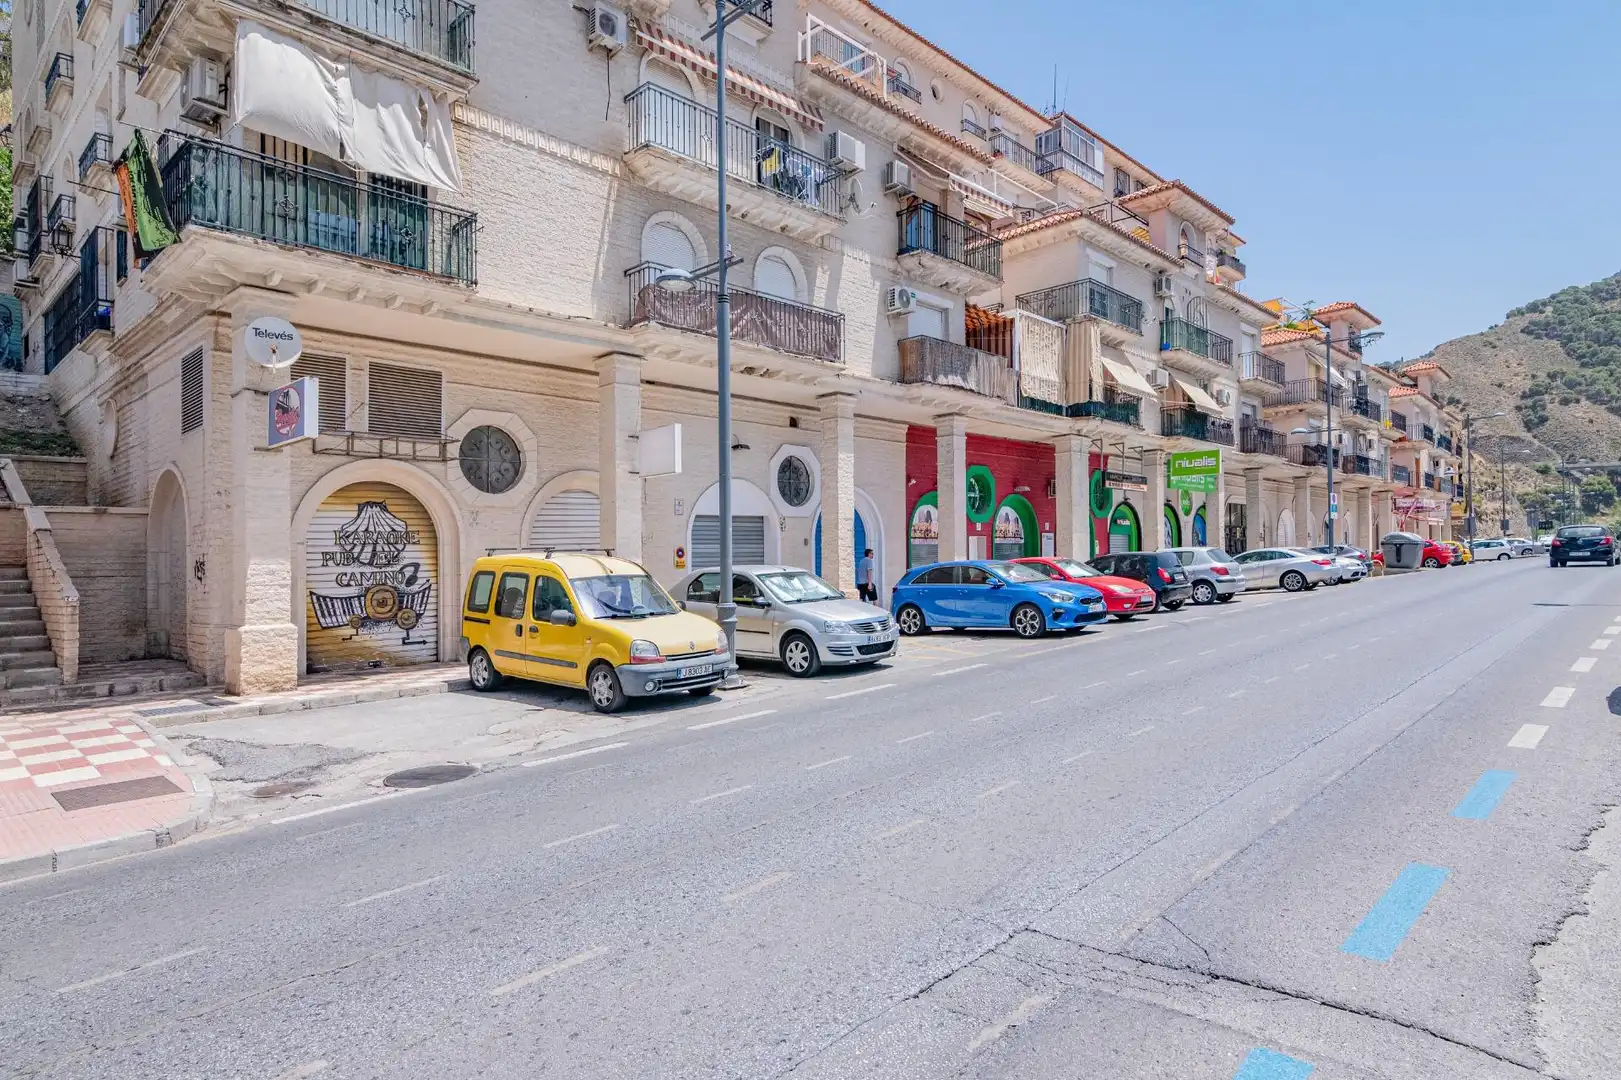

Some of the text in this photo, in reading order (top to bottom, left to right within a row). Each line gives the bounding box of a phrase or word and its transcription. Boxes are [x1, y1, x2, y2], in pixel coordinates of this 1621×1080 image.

[252, 327, 294, 341] Televés
[334, 530, 420, 544] KARAOKE
[321, 552, 399, 566] PUB EL
[336, 572, 406, 587] CAMINO
